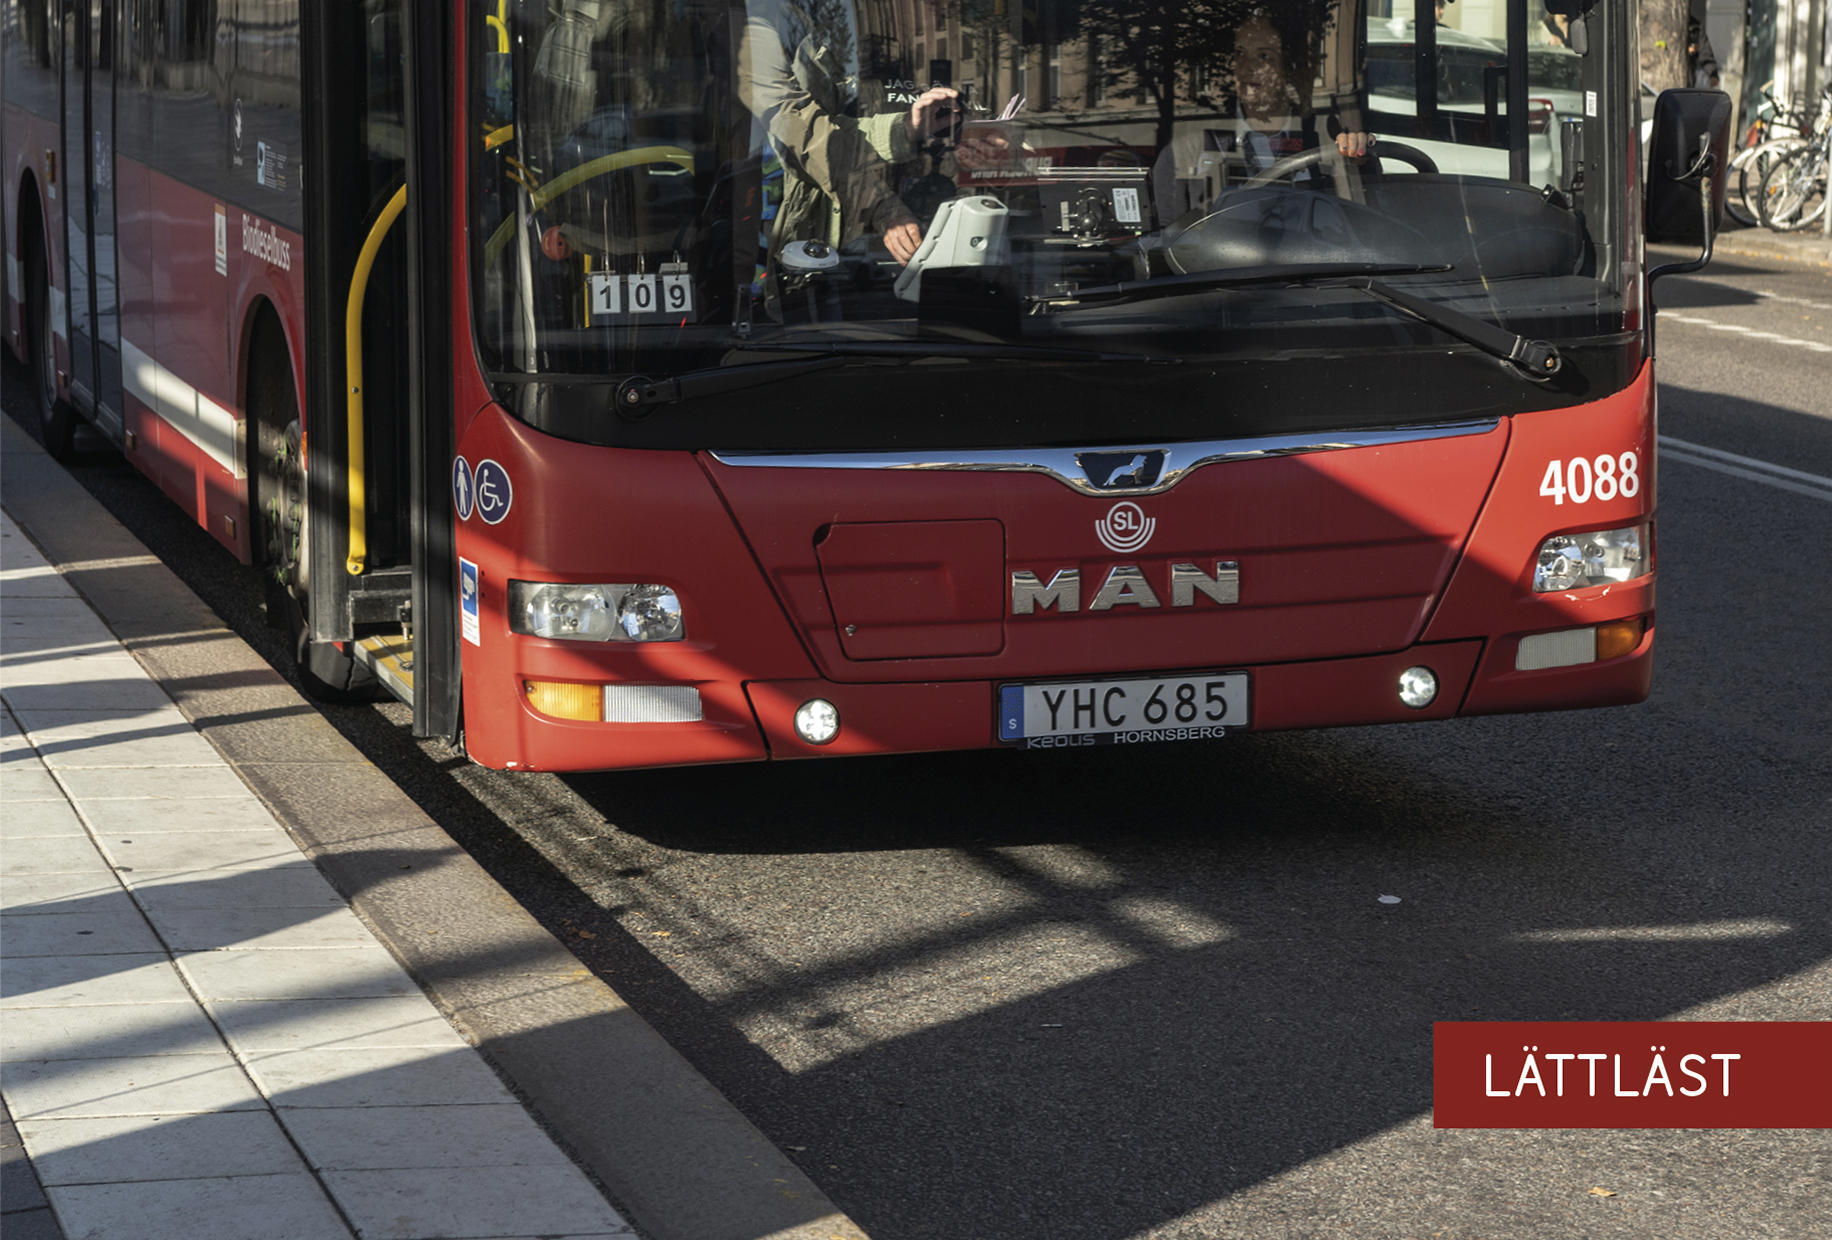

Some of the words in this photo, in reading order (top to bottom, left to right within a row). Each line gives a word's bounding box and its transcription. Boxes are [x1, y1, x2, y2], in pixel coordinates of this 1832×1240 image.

[884, 79, 915, 90] JAG
[887, 92, 920, 104] FAN
[243, 213, 291, 271] Biodieselbuss
[1539, 451, 1640, 505] 4088
[1113, 511, 1139, 530] SL
[1012, 560, 1239, 615] MAN
[1042, 686, 1127, 731] YHC
[1143, 681, 1228, 725] 685
[1008, 718, 1018, 730] S
[1113, 726, 1226, 745] HORNSBERG
